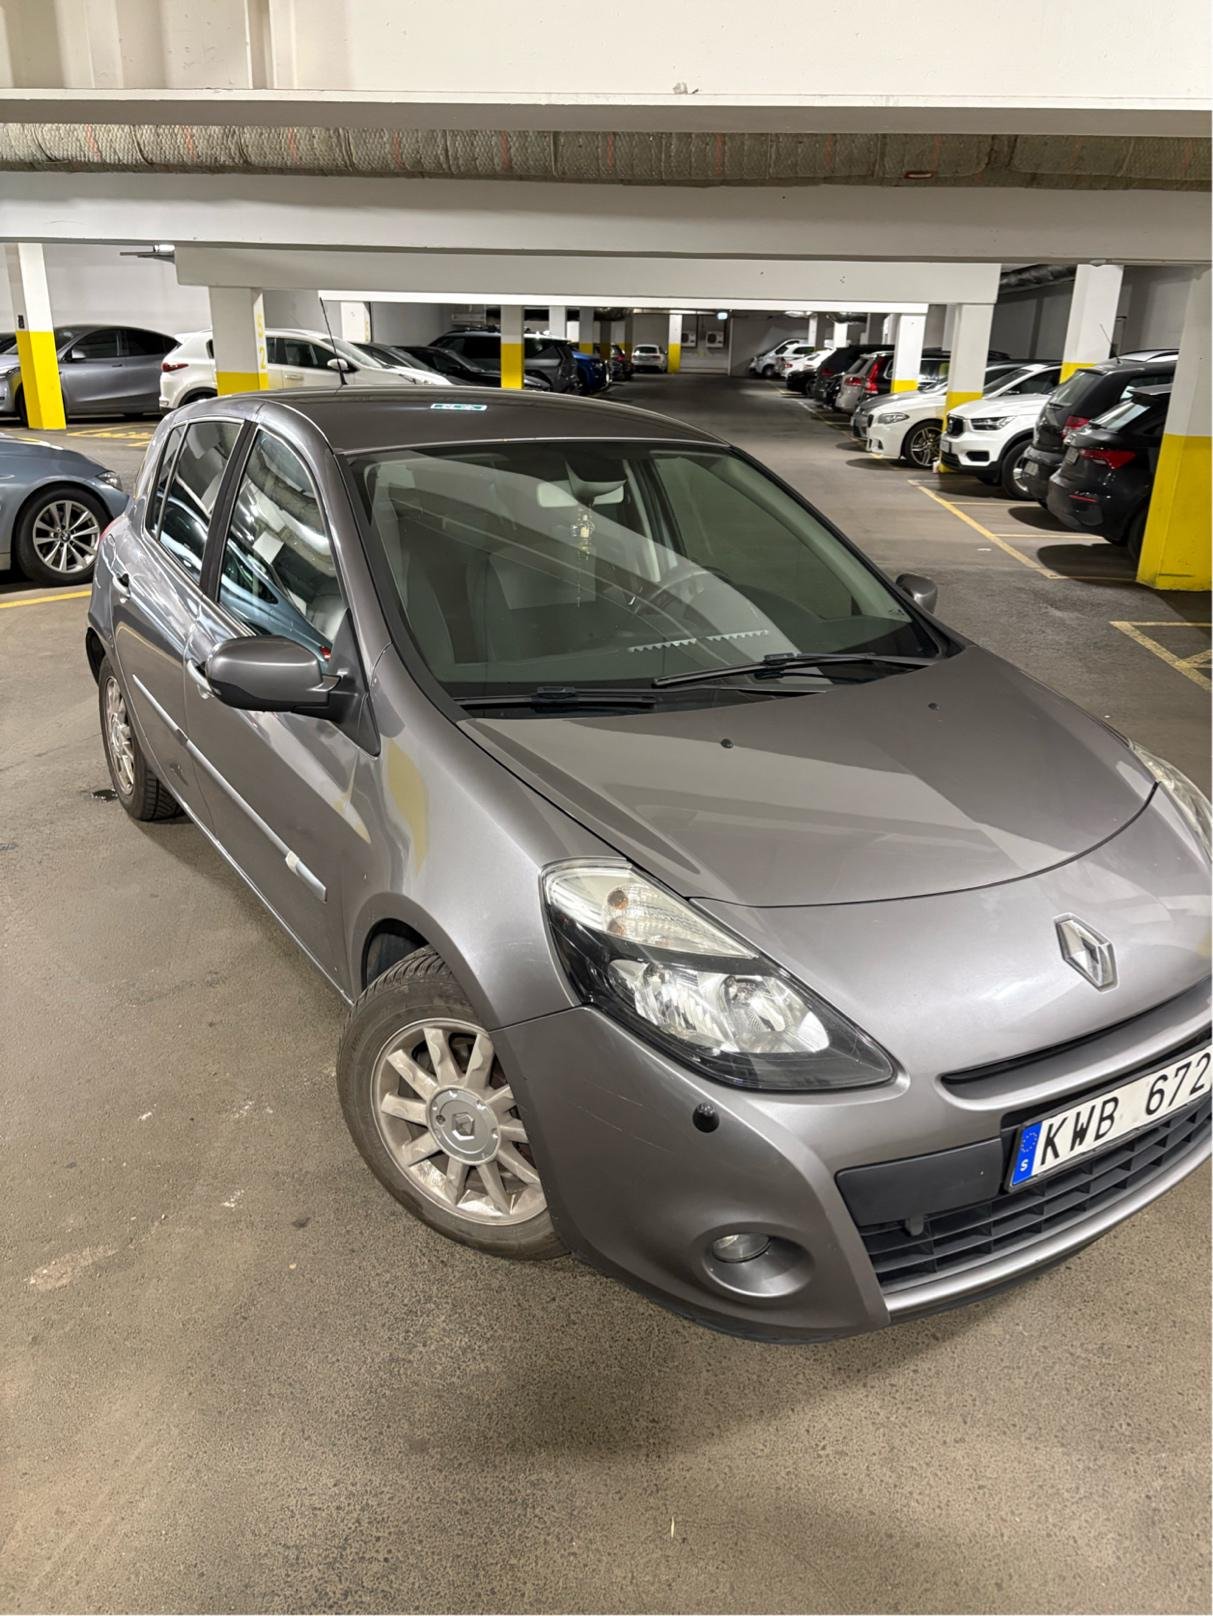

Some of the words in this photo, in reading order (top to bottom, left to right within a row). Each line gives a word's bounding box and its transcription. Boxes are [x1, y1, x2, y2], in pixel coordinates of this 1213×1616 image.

[1041, 1097, 1119, 1166] KWB
[1145, 1052, 1211, 1116] 672
[1020, 1159, 1029, 1172] S
